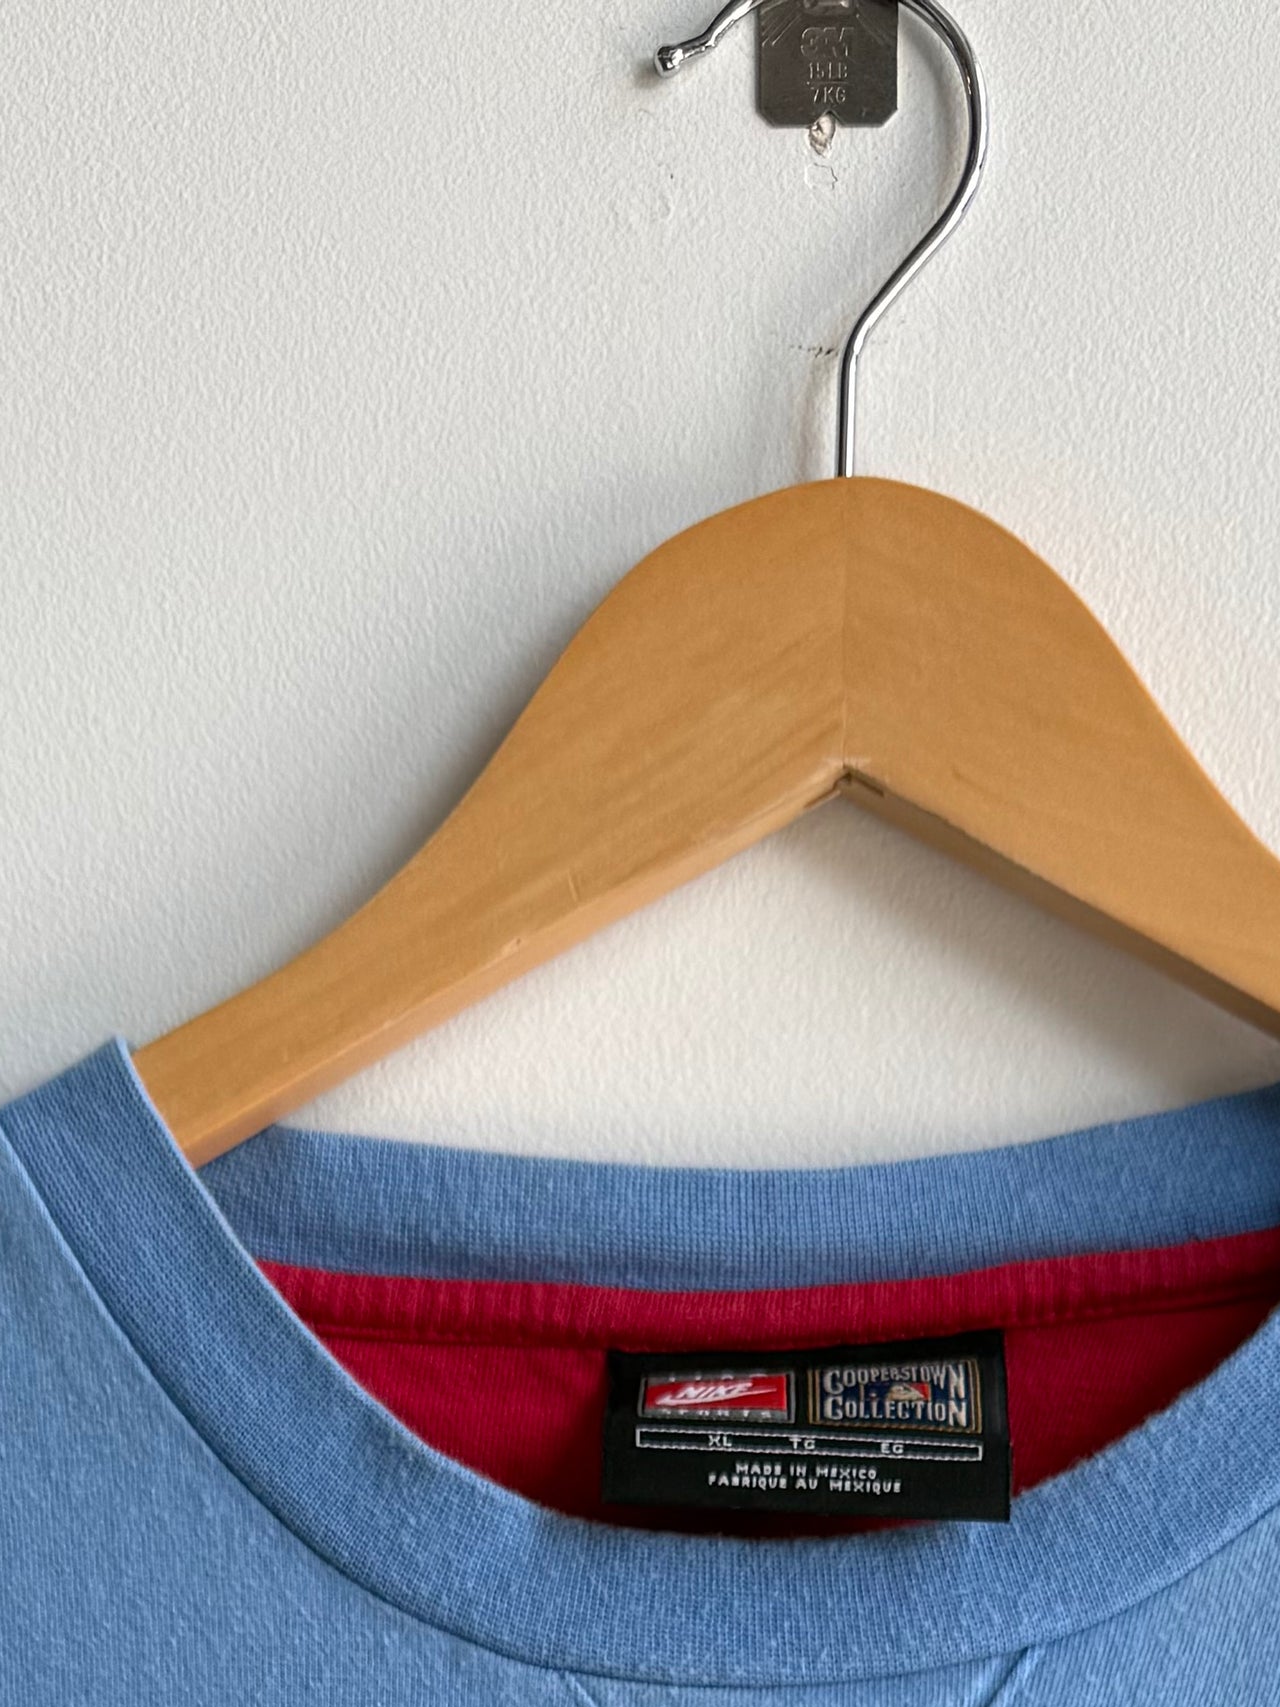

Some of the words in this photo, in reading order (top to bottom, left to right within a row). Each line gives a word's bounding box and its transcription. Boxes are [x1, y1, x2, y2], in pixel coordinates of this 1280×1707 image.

[823, 1361, 966, 1399] COOPERSTOWN
[677, 1381, 754, 1400] NIKE
[823, 1396, 967, 1427] COLLECTION
[707, 1435, 733, 1448] XL
[790, 1437, 816, 1450] TG
[880, 1442, 905, 1454] EG
[735, 1462, 781, 1476] MADE
[789, 1464, 807, 1476] IN
[816, 1465, 877, 1480] MEXICO
[708, 1473, 788, 1490] FABRIQUE
[795, 1477, 818, 1491] AU
[829, 1479, 902, 1494] MEXIQUE
